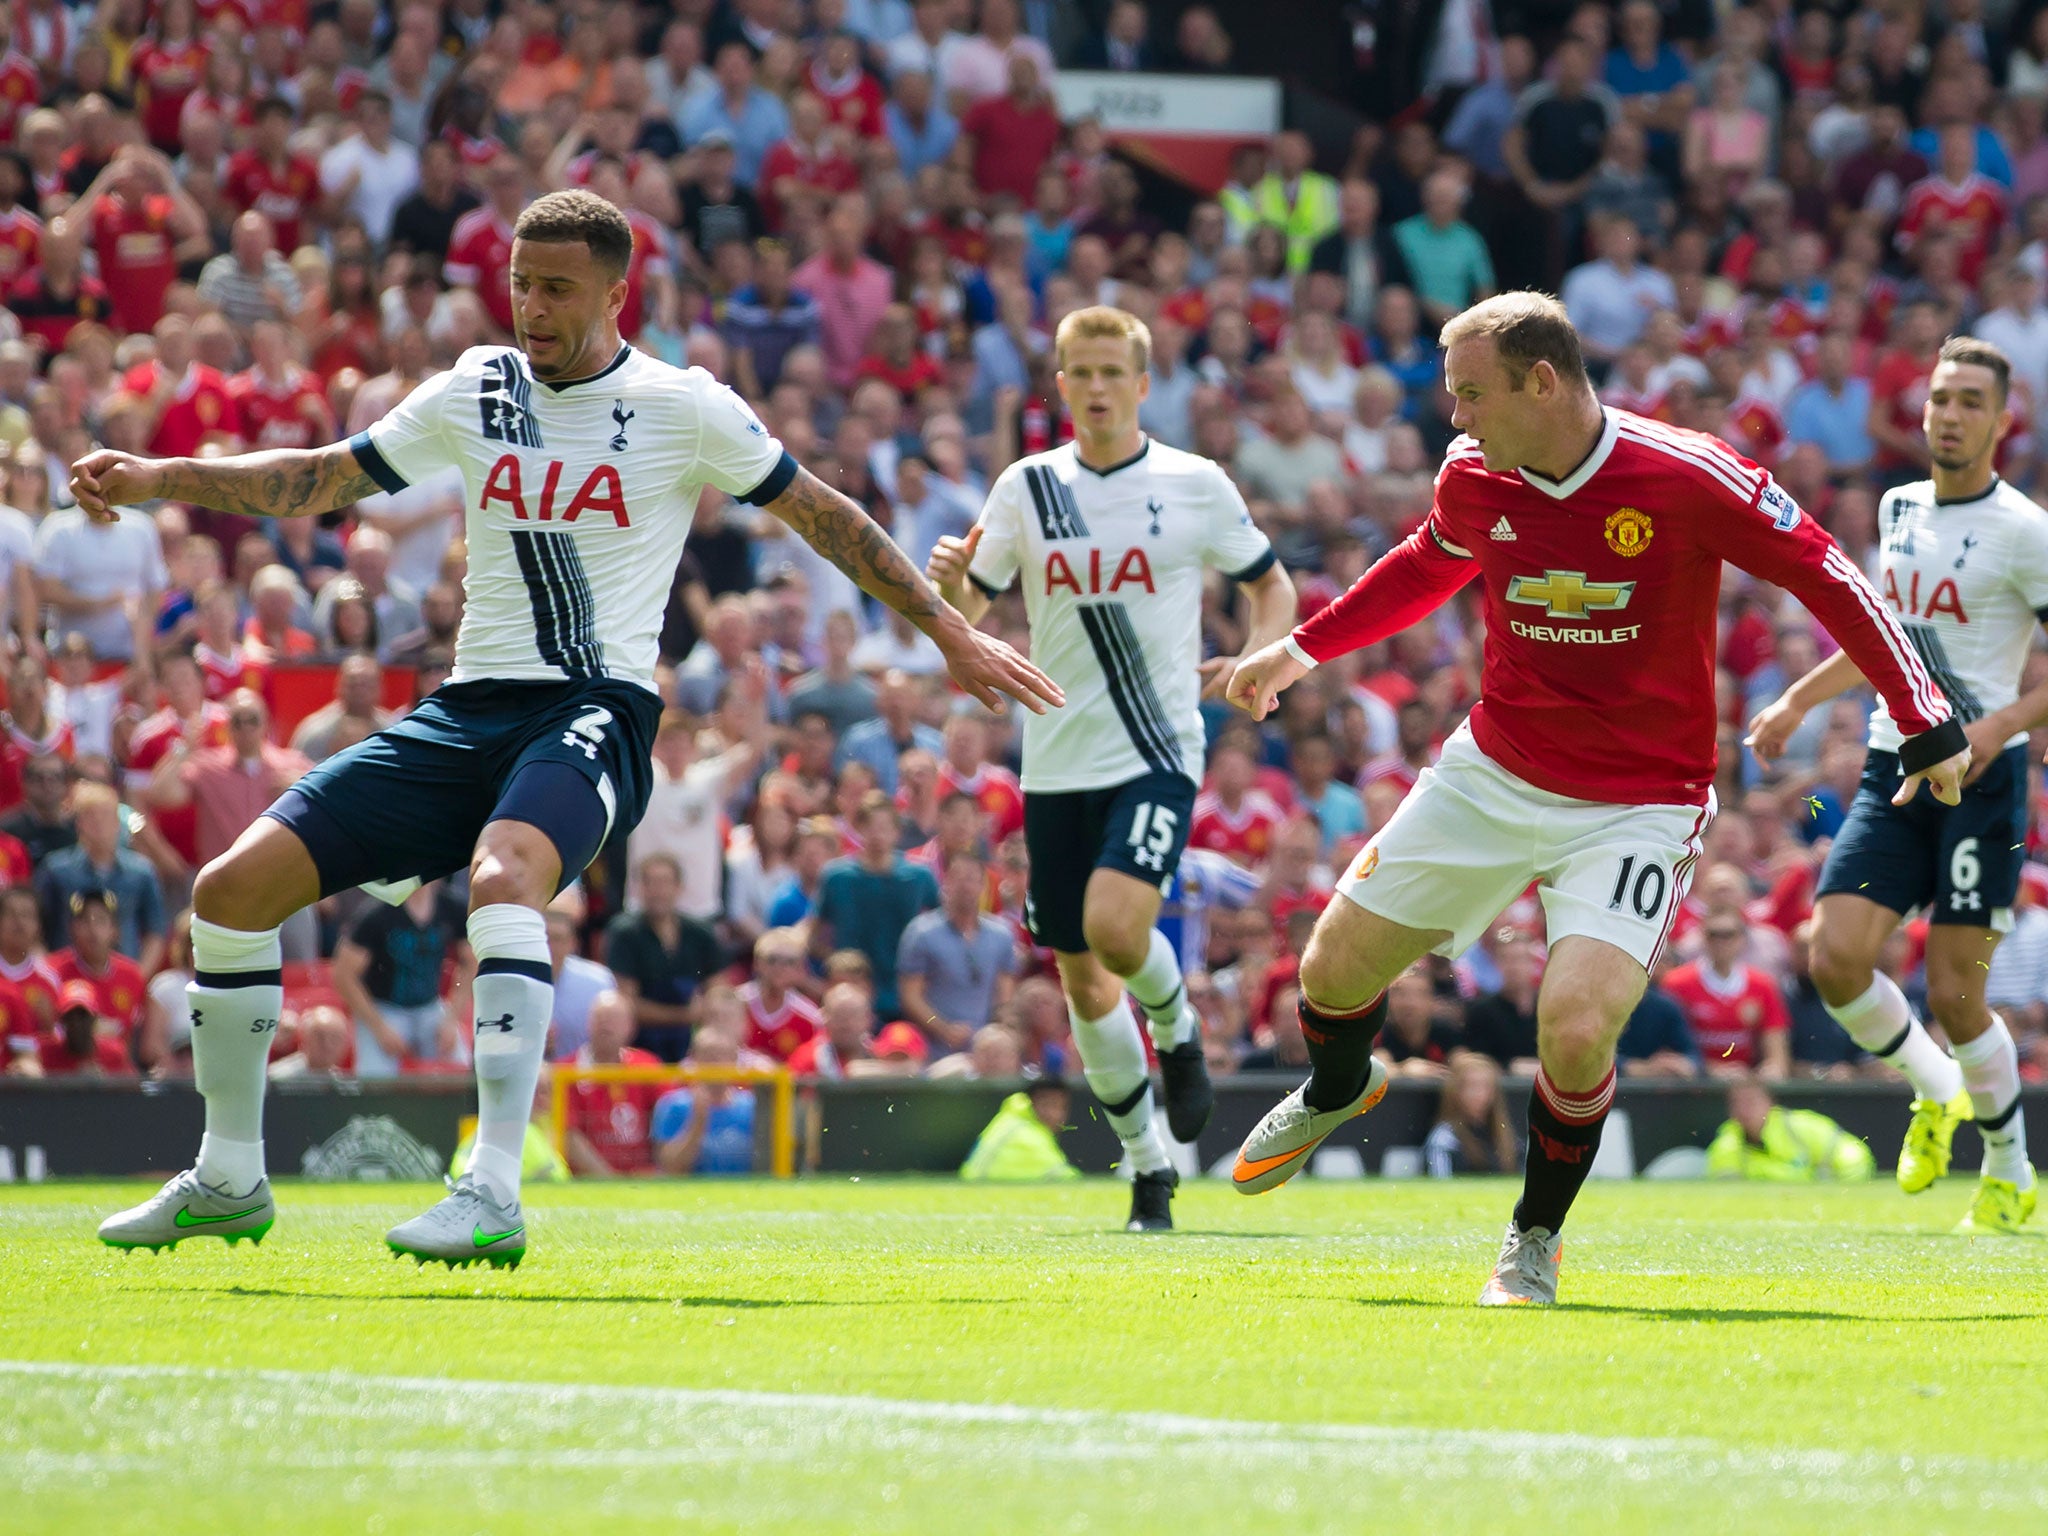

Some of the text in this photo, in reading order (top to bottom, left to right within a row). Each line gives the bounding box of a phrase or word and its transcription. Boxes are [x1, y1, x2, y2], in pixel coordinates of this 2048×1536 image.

[479, 453, 631, 528] AIA
[1044, 546, 1157, 596] AIA
[1885, 566, 1970, 624] AIA
[1510, 619, 1642, 644] CHEVROLET
[569, 704, 613, 744] 2
[1126, 801, 1178, 855] 15
[1607, 853, 1667, 922] 10
[1950, 836, 1981, 891] 6
